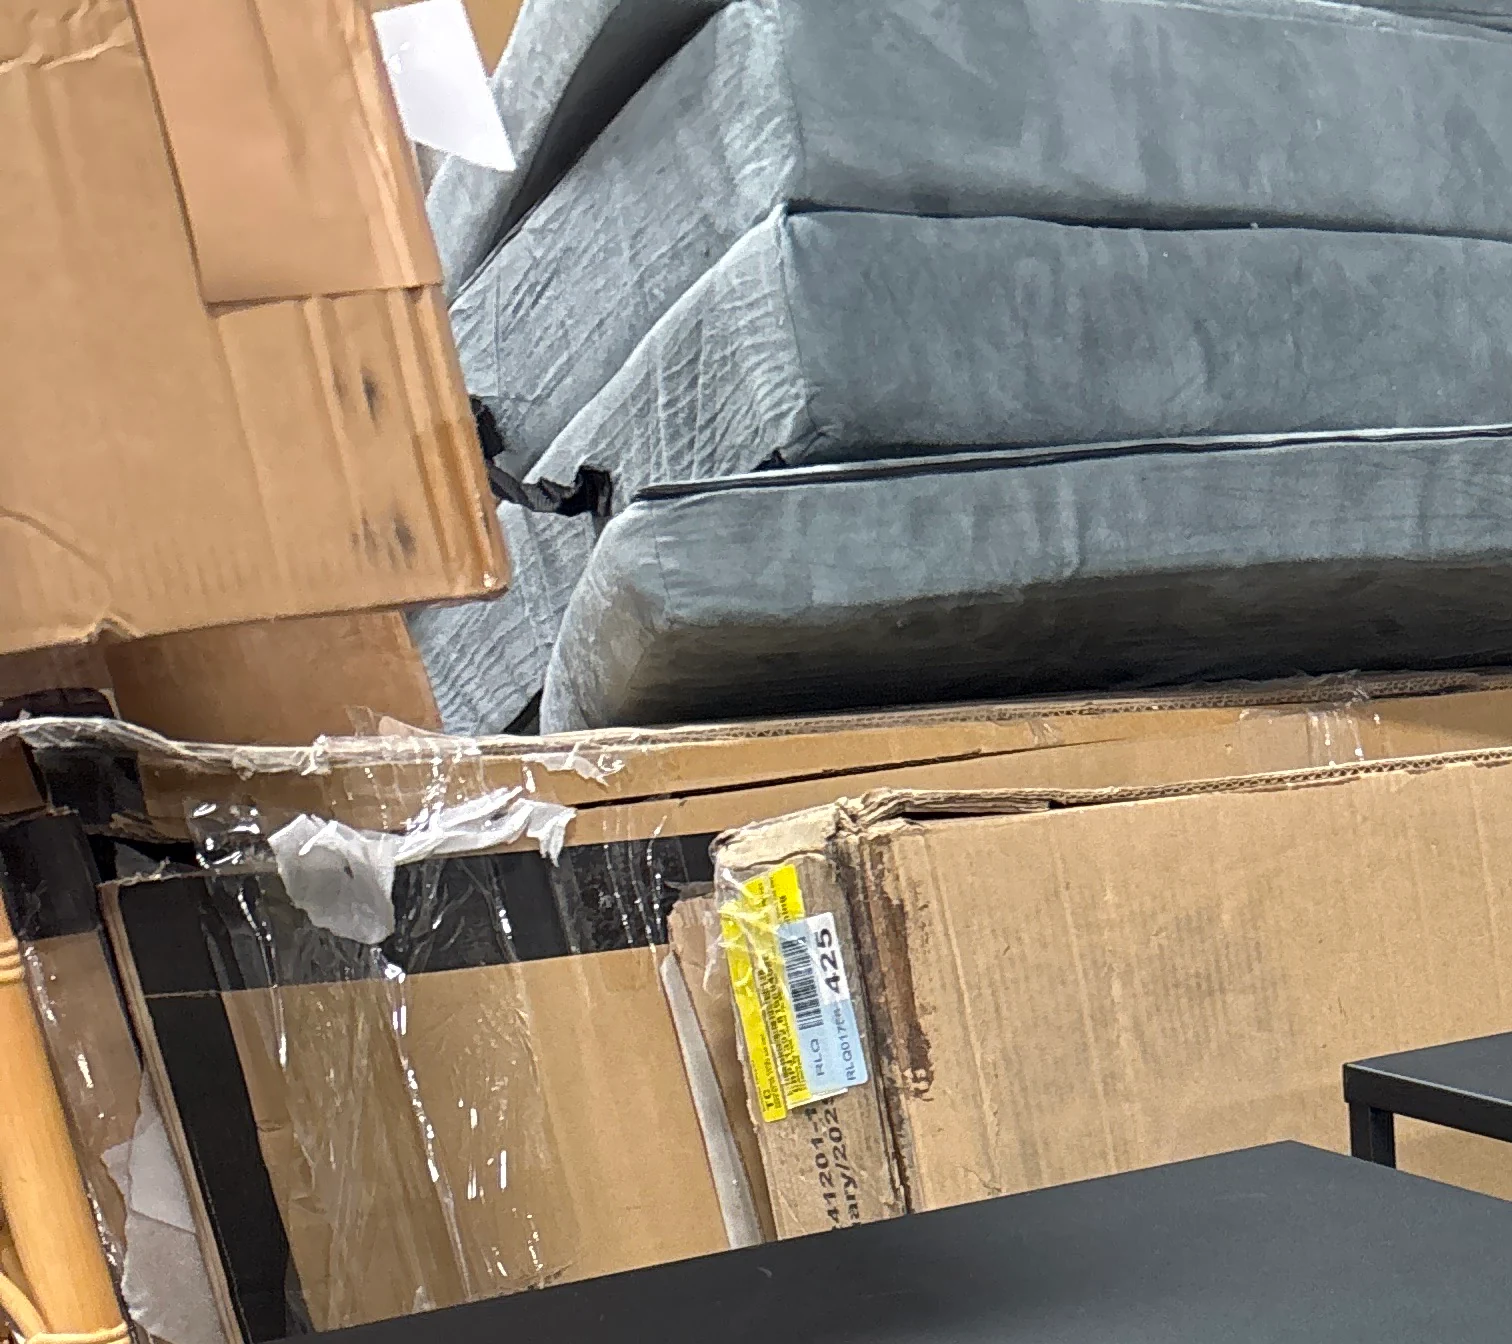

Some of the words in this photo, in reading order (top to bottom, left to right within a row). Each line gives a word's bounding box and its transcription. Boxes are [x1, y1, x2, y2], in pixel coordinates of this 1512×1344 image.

[815, 927, 841, 996] 425
[810, 1038, 825, 1077] RLQ
[805, 1107, 840, 1229] 41201-1
[821, 1096, 861, 1226] ary/202
